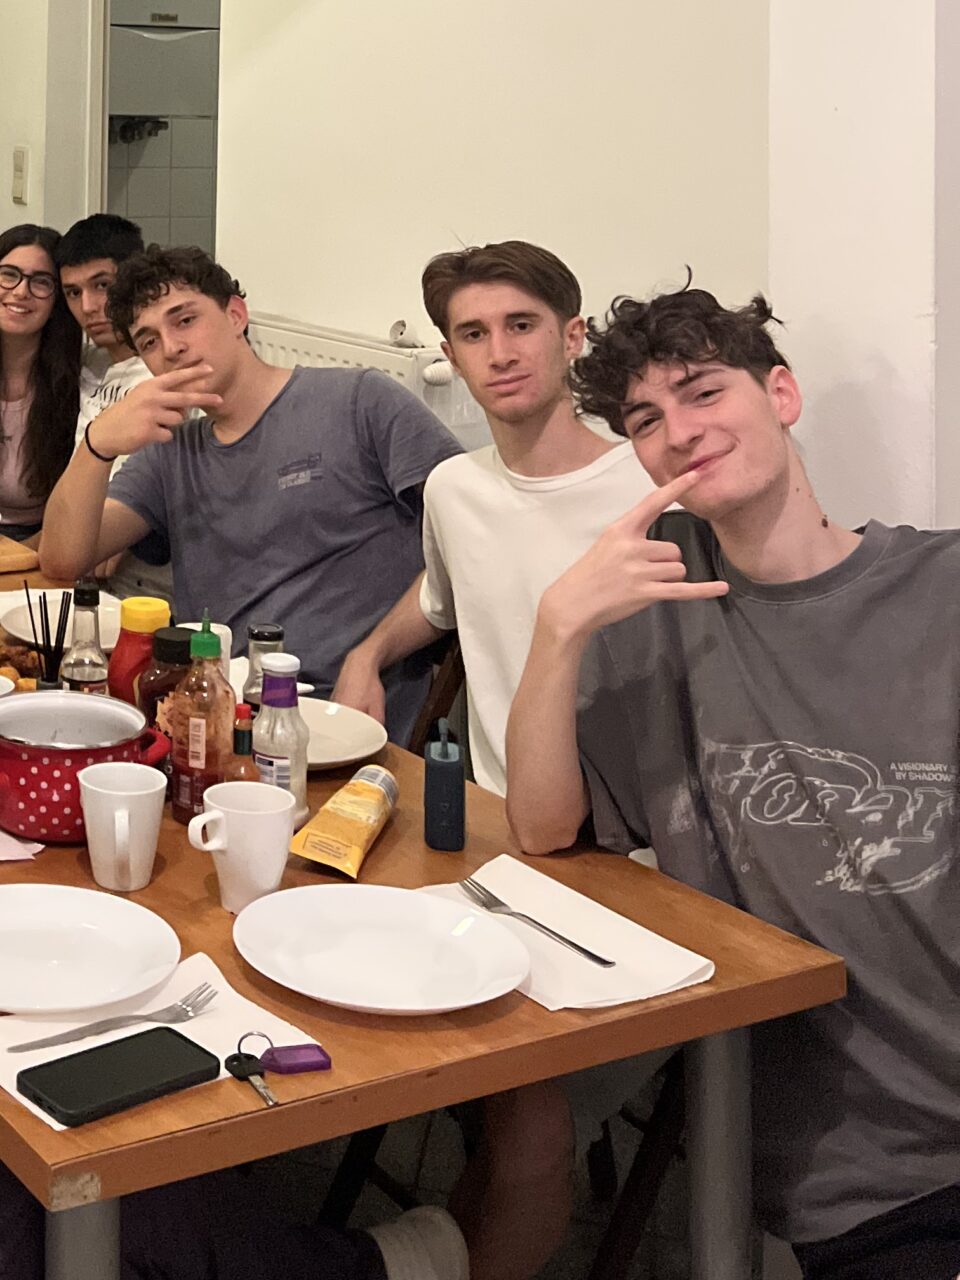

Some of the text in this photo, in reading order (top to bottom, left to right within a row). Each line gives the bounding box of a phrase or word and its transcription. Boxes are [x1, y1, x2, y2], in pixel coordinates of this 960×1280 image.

[890, 762, 897, 770] A
[897, 762, 948, 772] VISIONARY
[895, 771, 907, 780] BY
